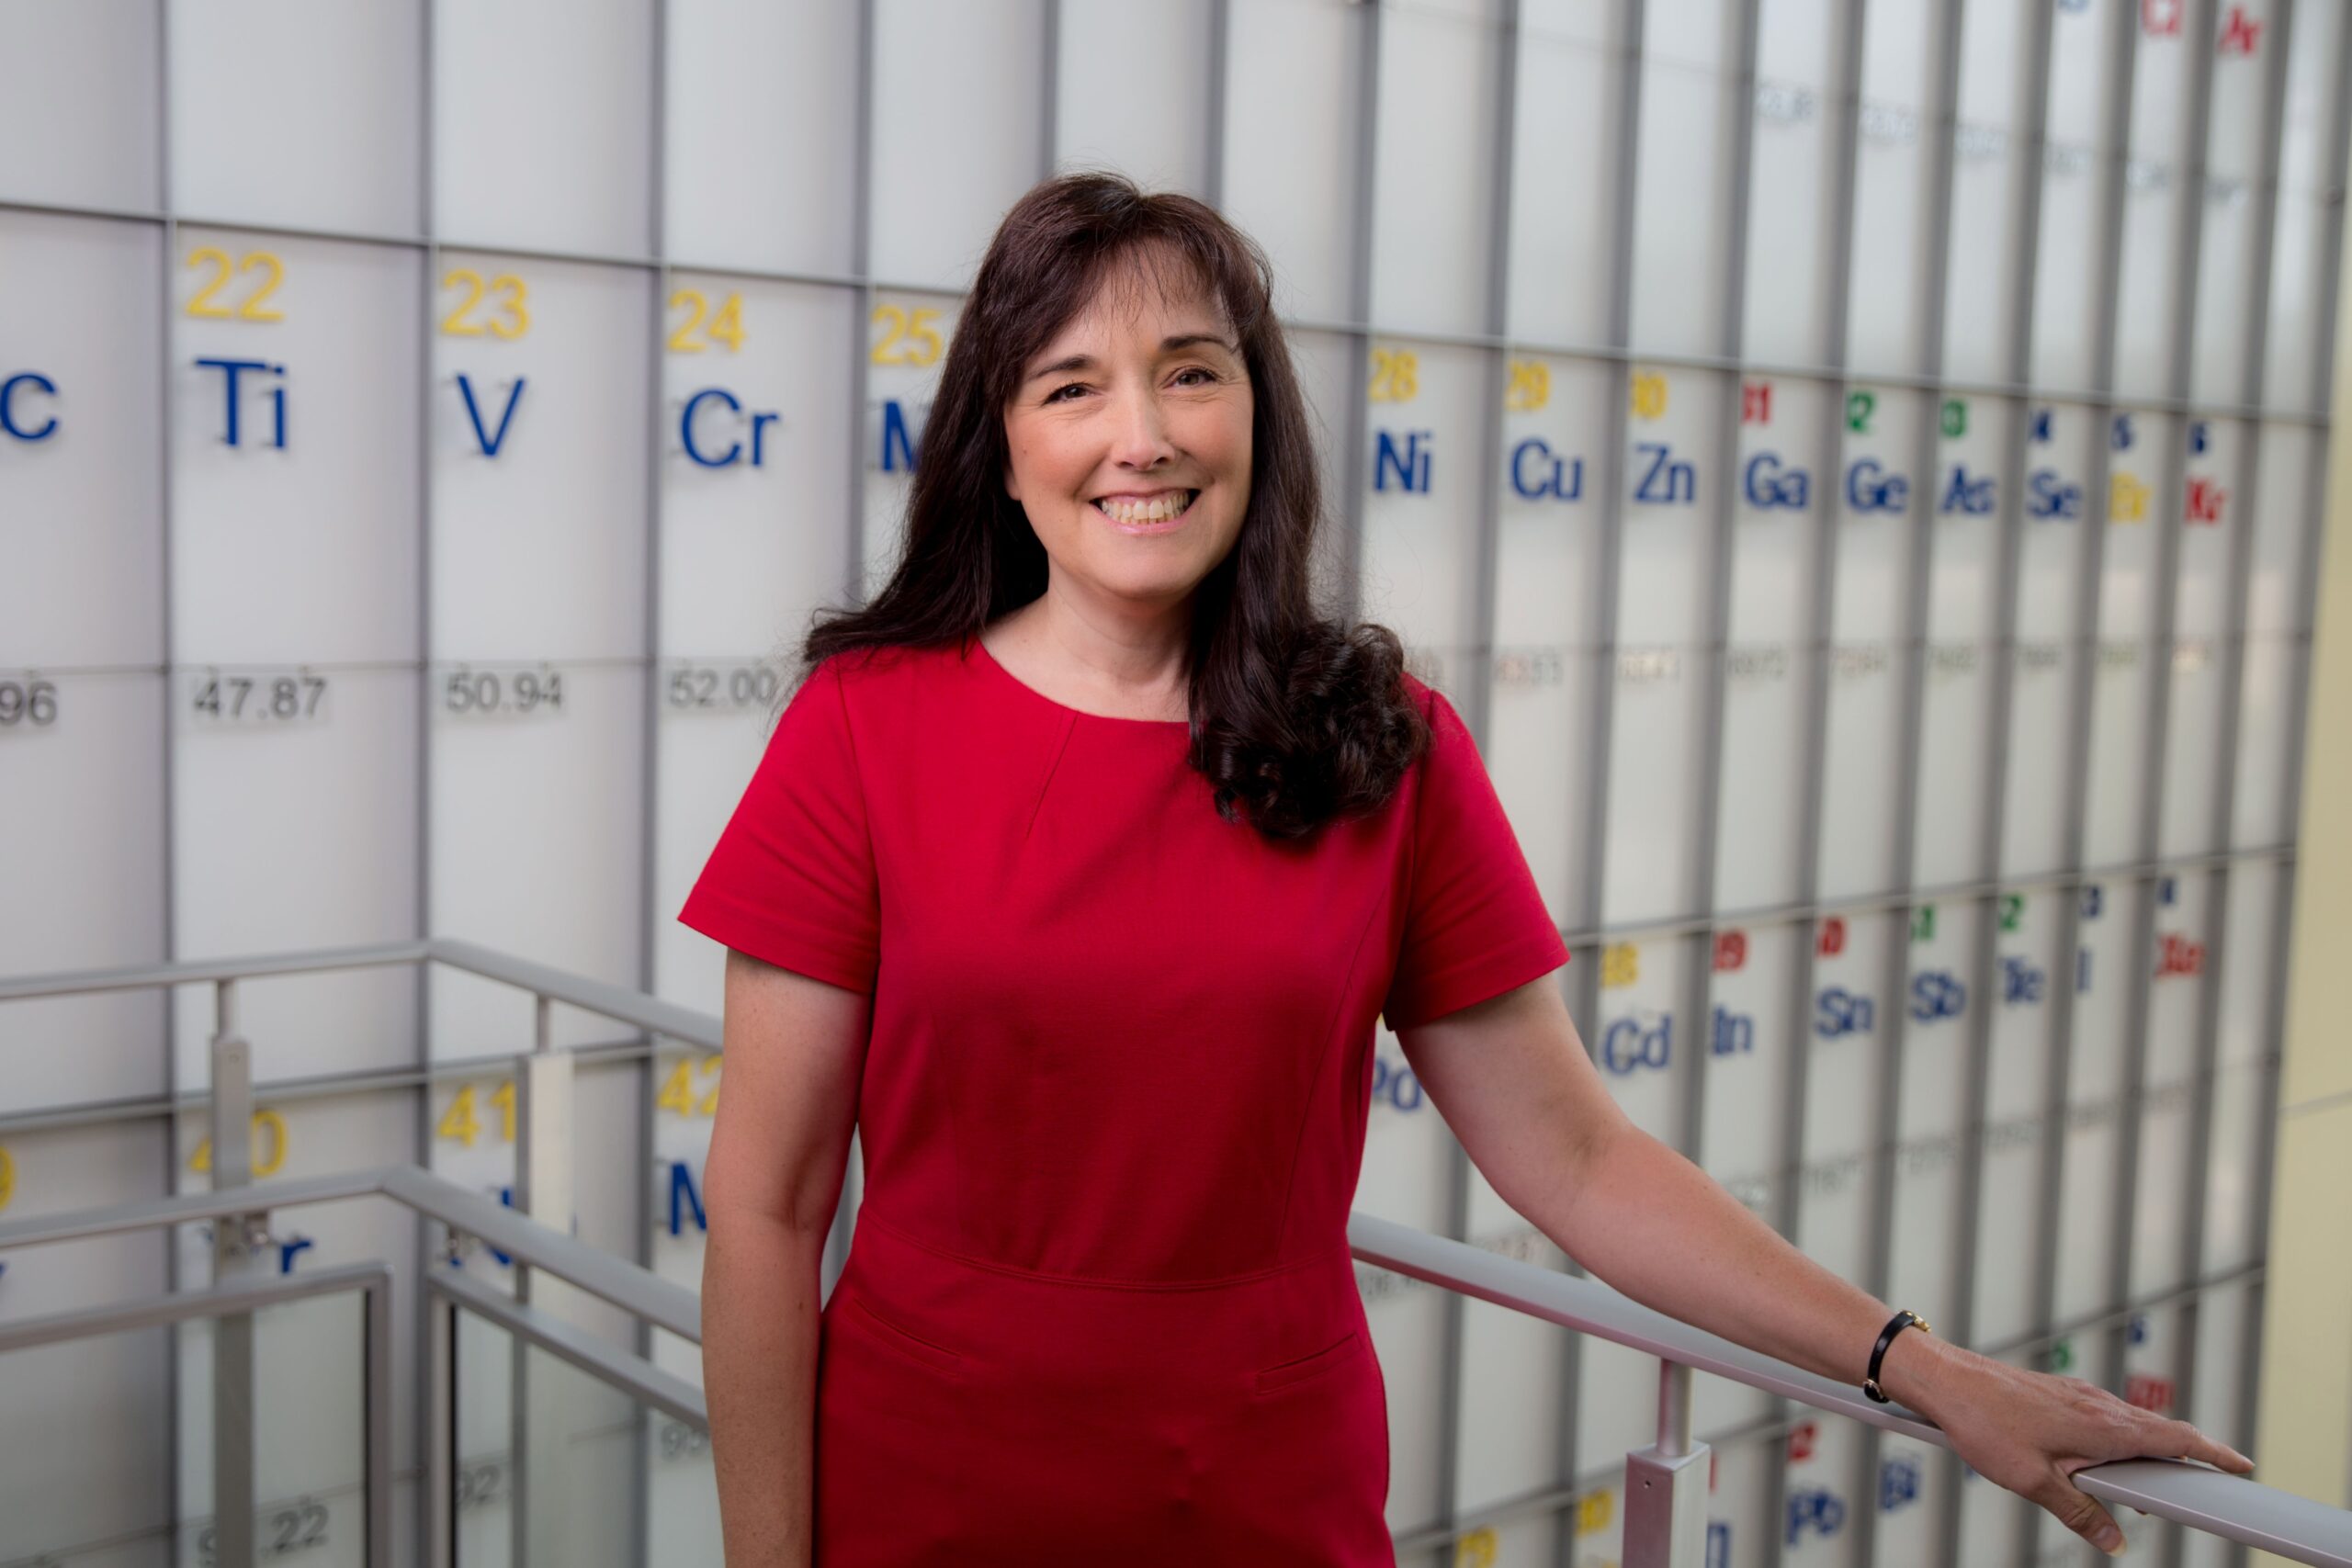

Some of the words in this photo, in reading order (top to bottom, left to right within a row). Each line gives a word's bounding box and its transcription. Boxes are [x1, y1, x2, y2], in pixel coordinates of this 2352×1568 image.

[186, 246, 286, 322] 22
[441, 269, 531, 342] 23
[666, 289, 746, 354] 24
[869, 304, 944, 367] 25
[194, 356, 287, 450] Ti
[1369, 347, 1419, 404] 28
[457, 372, 527, 458] V
[681, 388, 779, 468] Cr
[1374, 431, 1434, 496] Ni
[1511, 437, 1585, 502] Cu
[1634, 444, 1697, 504] Zn
[1744, 450, 1810, 512] Ga
[1846, 457, 1909, 514] Ge
[1939, 463, 1995, 514] As
[2028, 469, 2082, 521] Se
[193, 675, 328, 721] 47.87
[446, 671, 564, 714] 50.94
[668, 667, 777, 708] 52.00
[1815, 986, 1874, 1038] Sn
[1911, 970, 1966, 1023] Sb
[1603, 1013, 1673, 1076] Cd
[437, 1081, 516, 1147] 41
